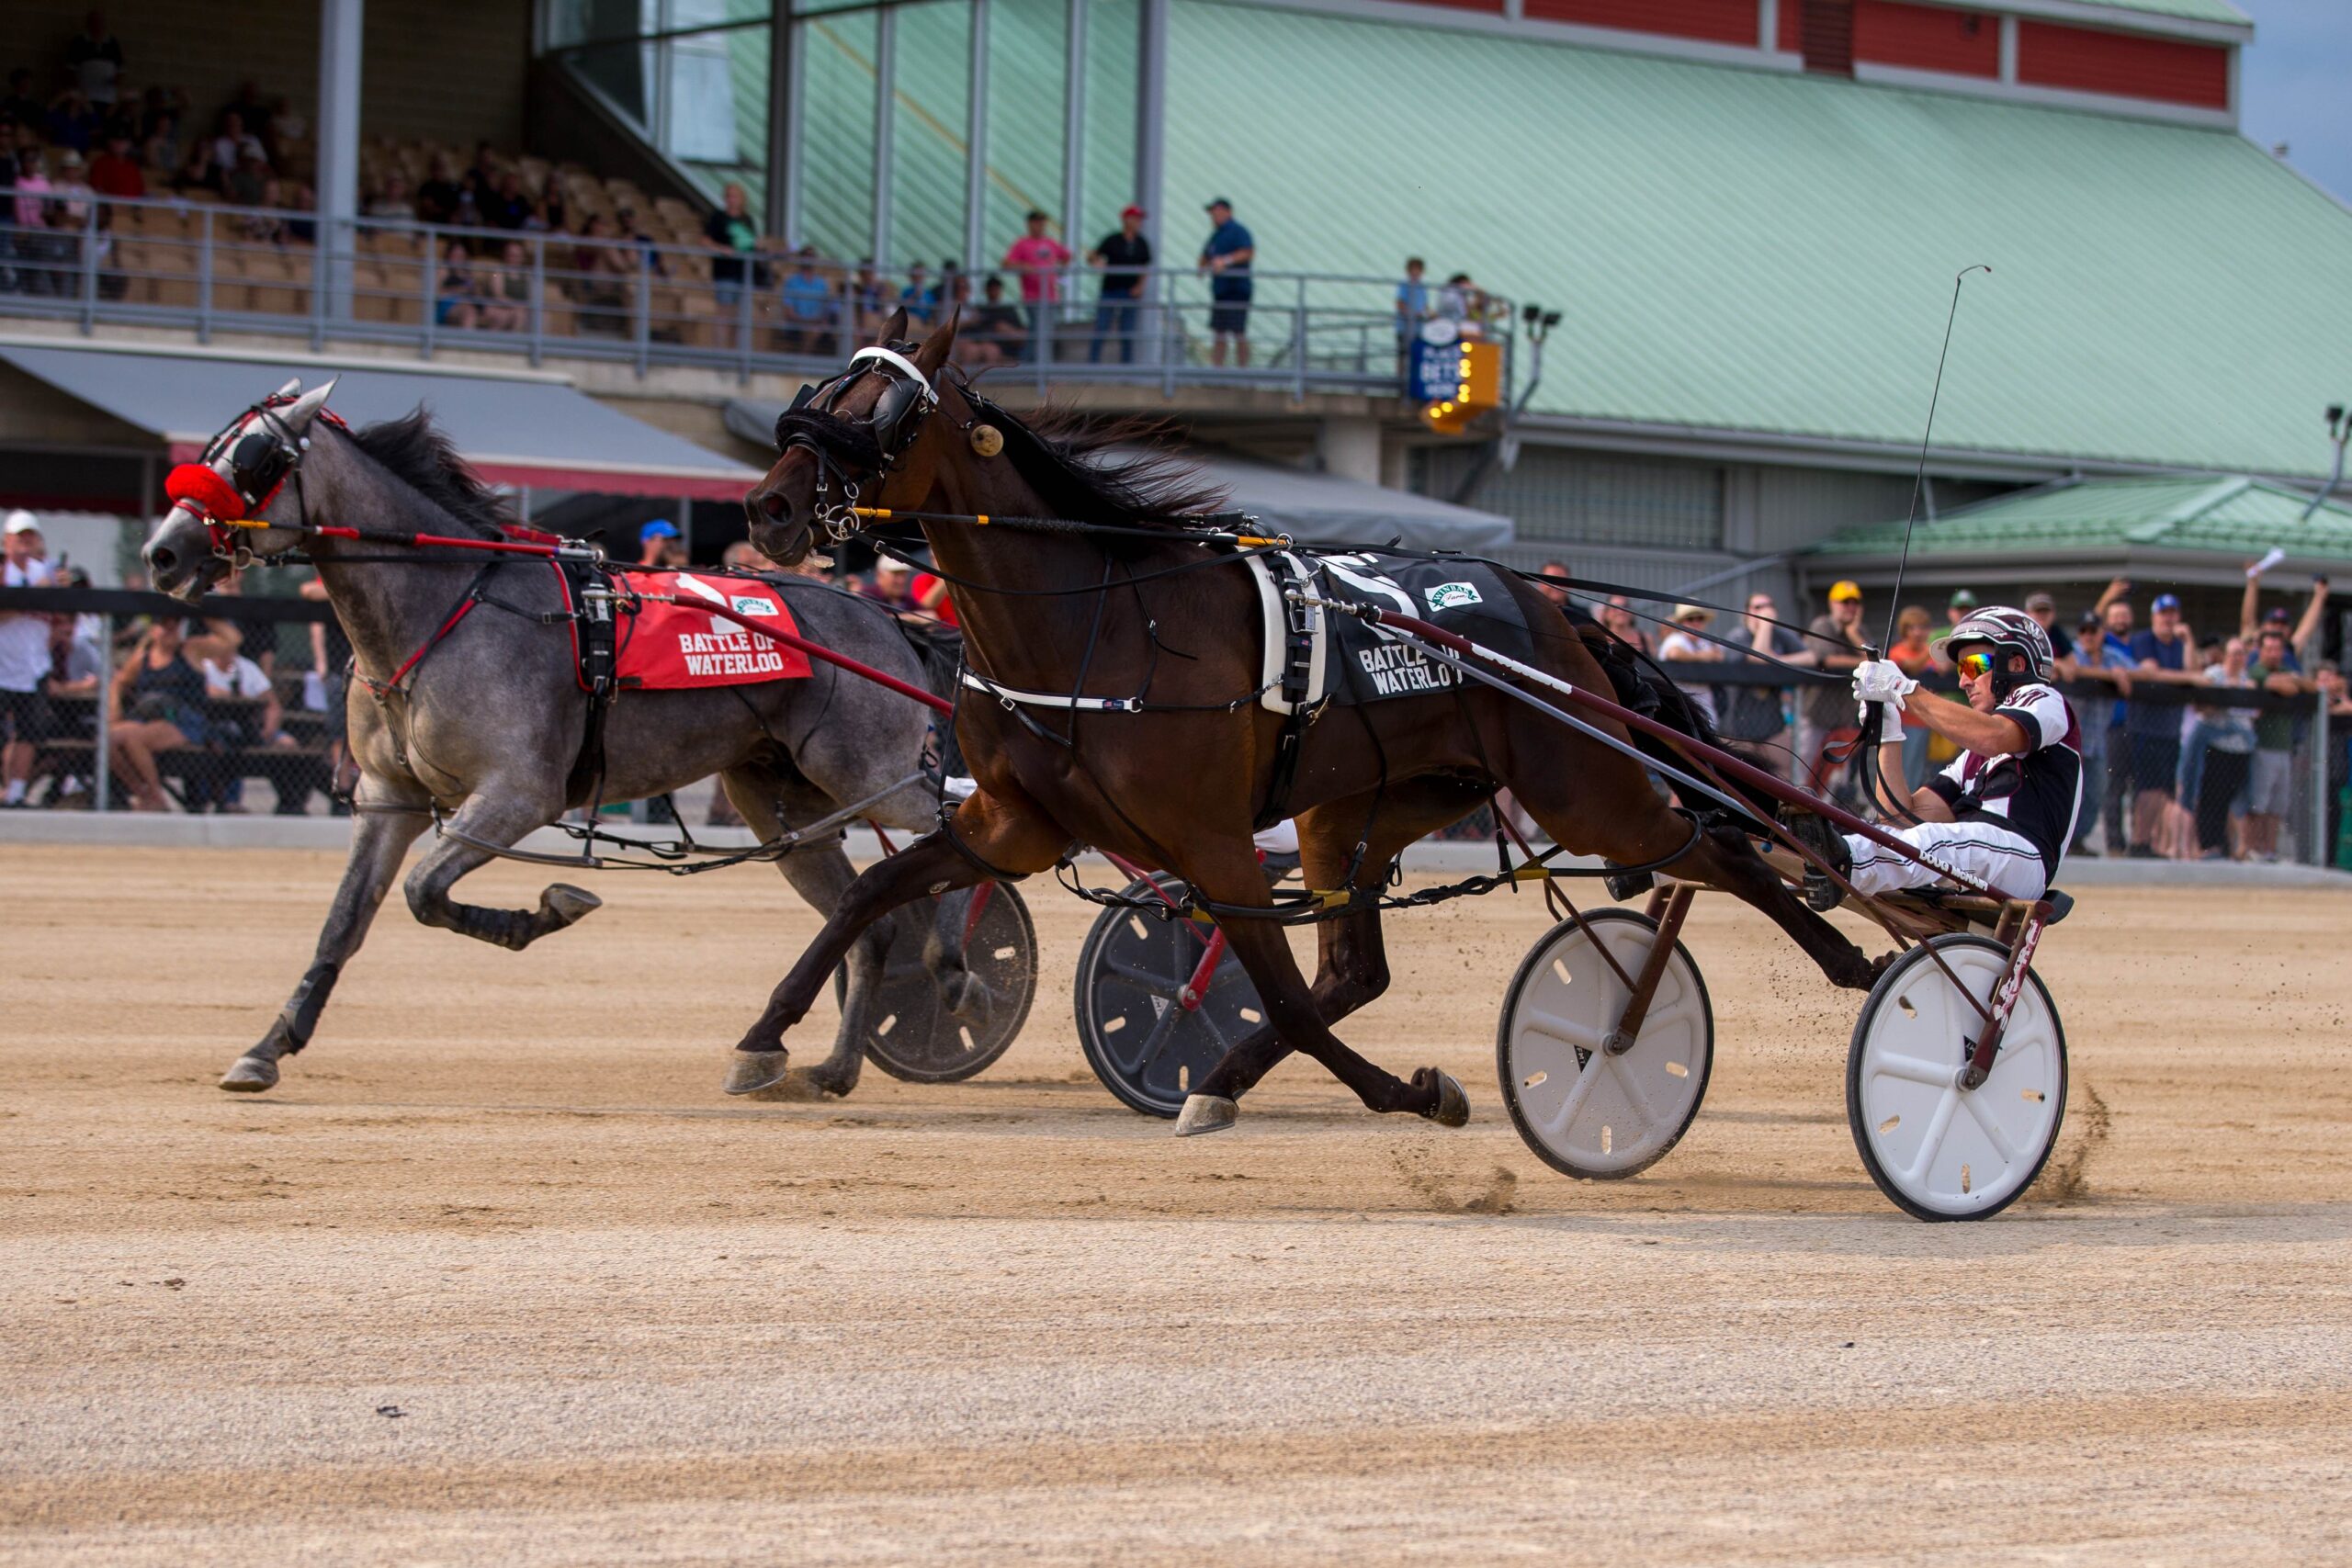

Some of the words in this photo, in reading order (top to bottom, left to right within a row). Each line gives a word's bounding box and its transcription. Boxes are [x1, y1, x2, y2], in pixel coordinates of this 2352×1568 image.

[675, 572, 746, 635] 1
[679, 632, 752, 653] BATTLE
[753, 632, 775, 651] OF
[684, 652, 784, 676] WATERLOO
[1359, 643, 1427, 672] BATTLE
[1919, 850, 1949, 872] DOUG
